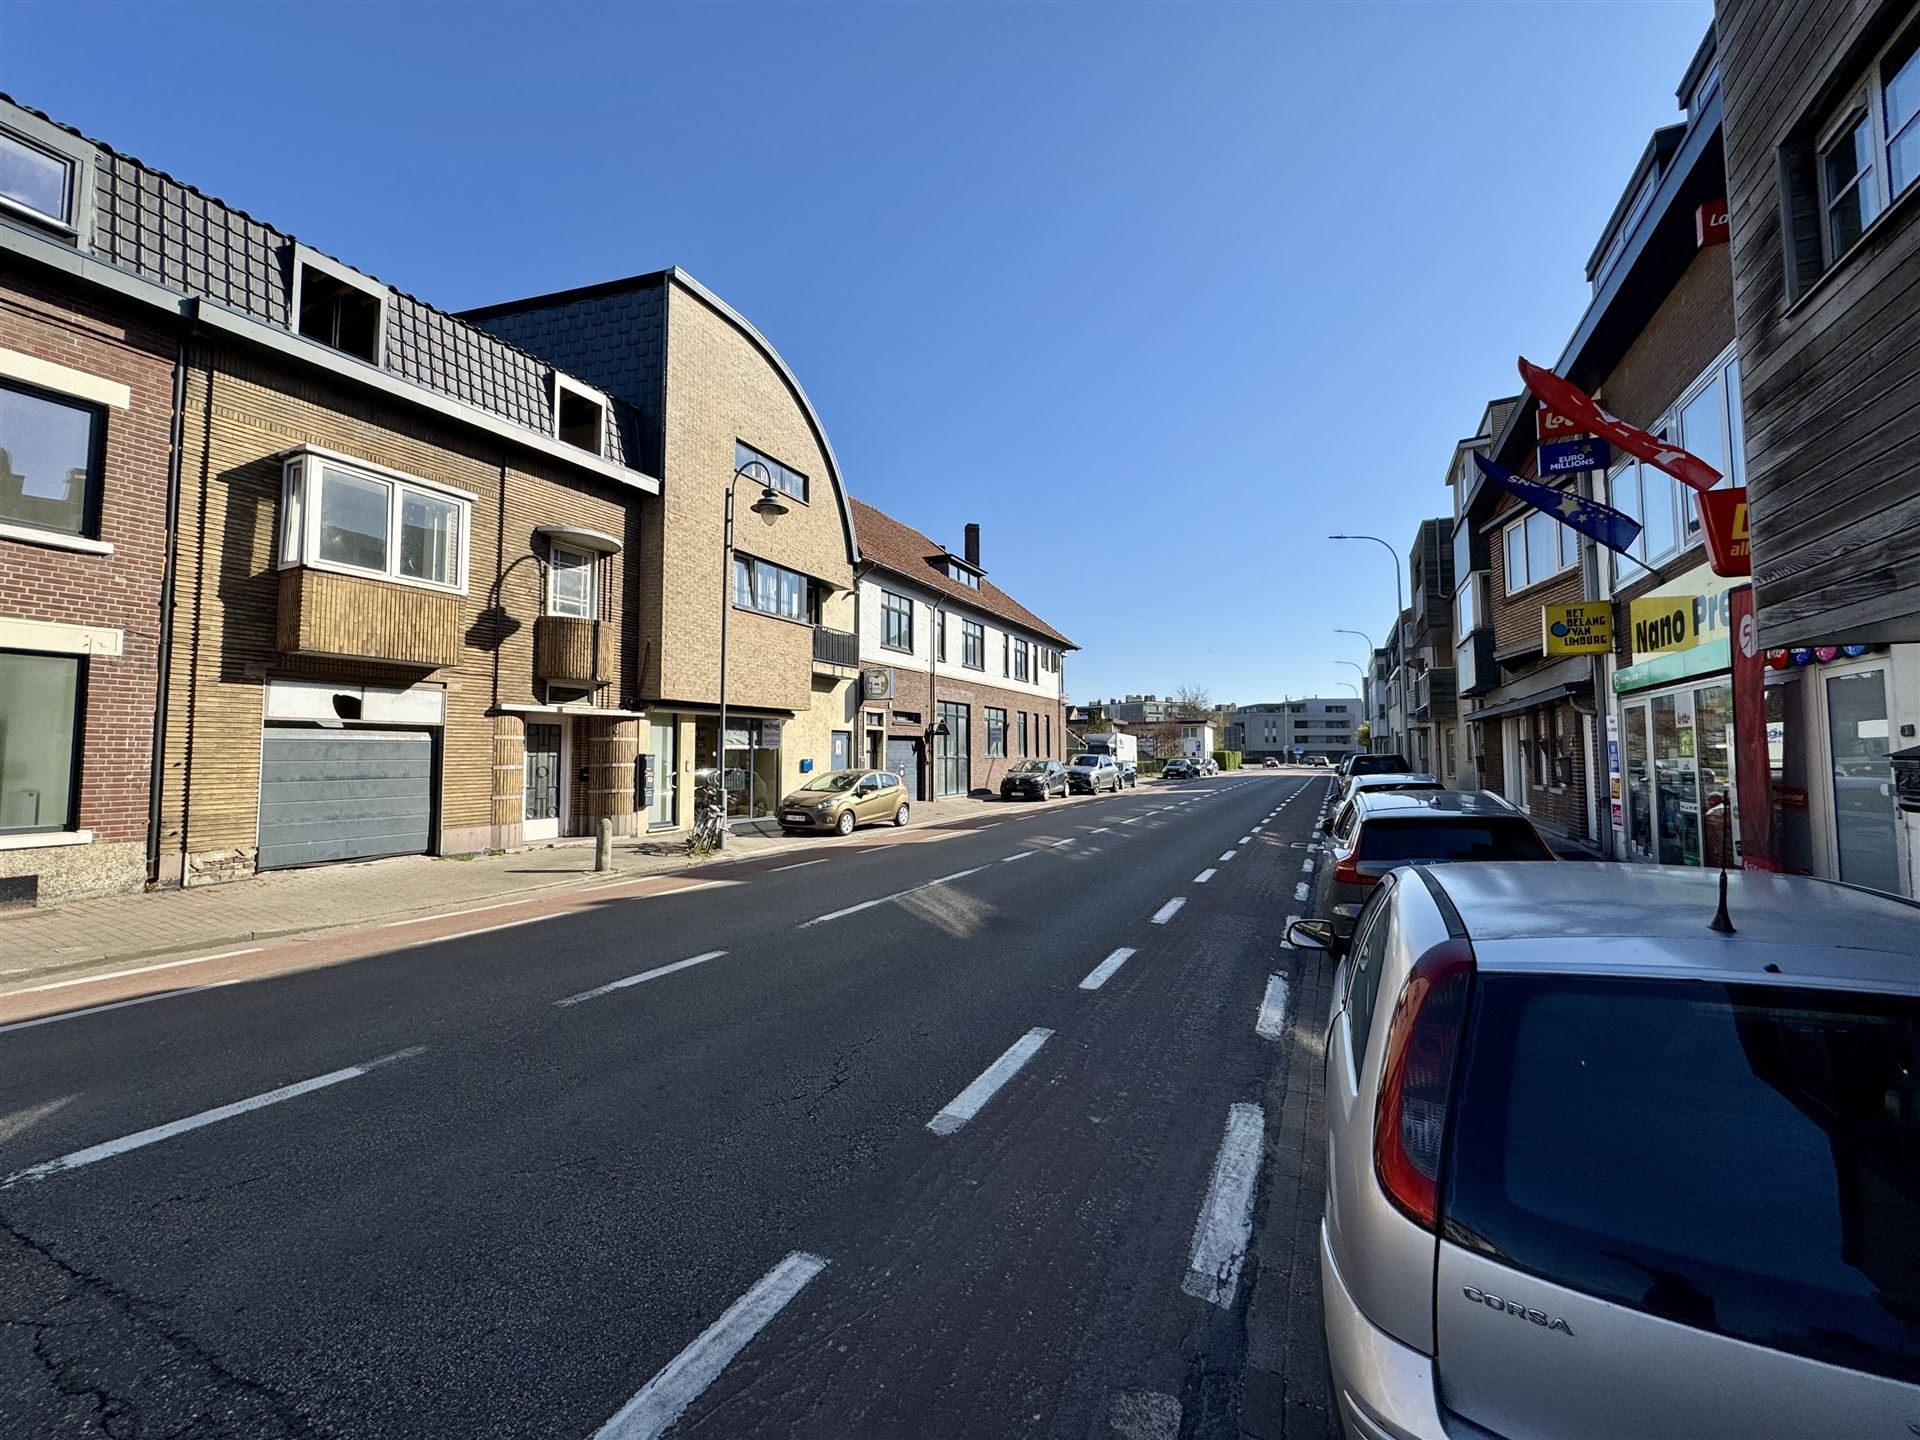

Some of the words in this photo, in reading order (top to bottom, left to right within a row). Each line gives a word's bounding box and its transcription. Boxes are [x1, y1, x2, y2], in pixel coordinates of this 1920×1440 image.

[1558, 453, 1585, 463] EURO
[1550, 458, 1595, 471] MILLIONS
[1566, 608, 1584, 618] HET
[1566, 616, 1606, 627] BELANG
[1635, 609, 1685, 653] Nano
[1692, 589, 1729, 636] Pre
[1570, 626, 1591, 636] VAN
[1564, 635, 1607, 646] LIMBURG
[1463, 1285, 1575, 1337] CORSA
